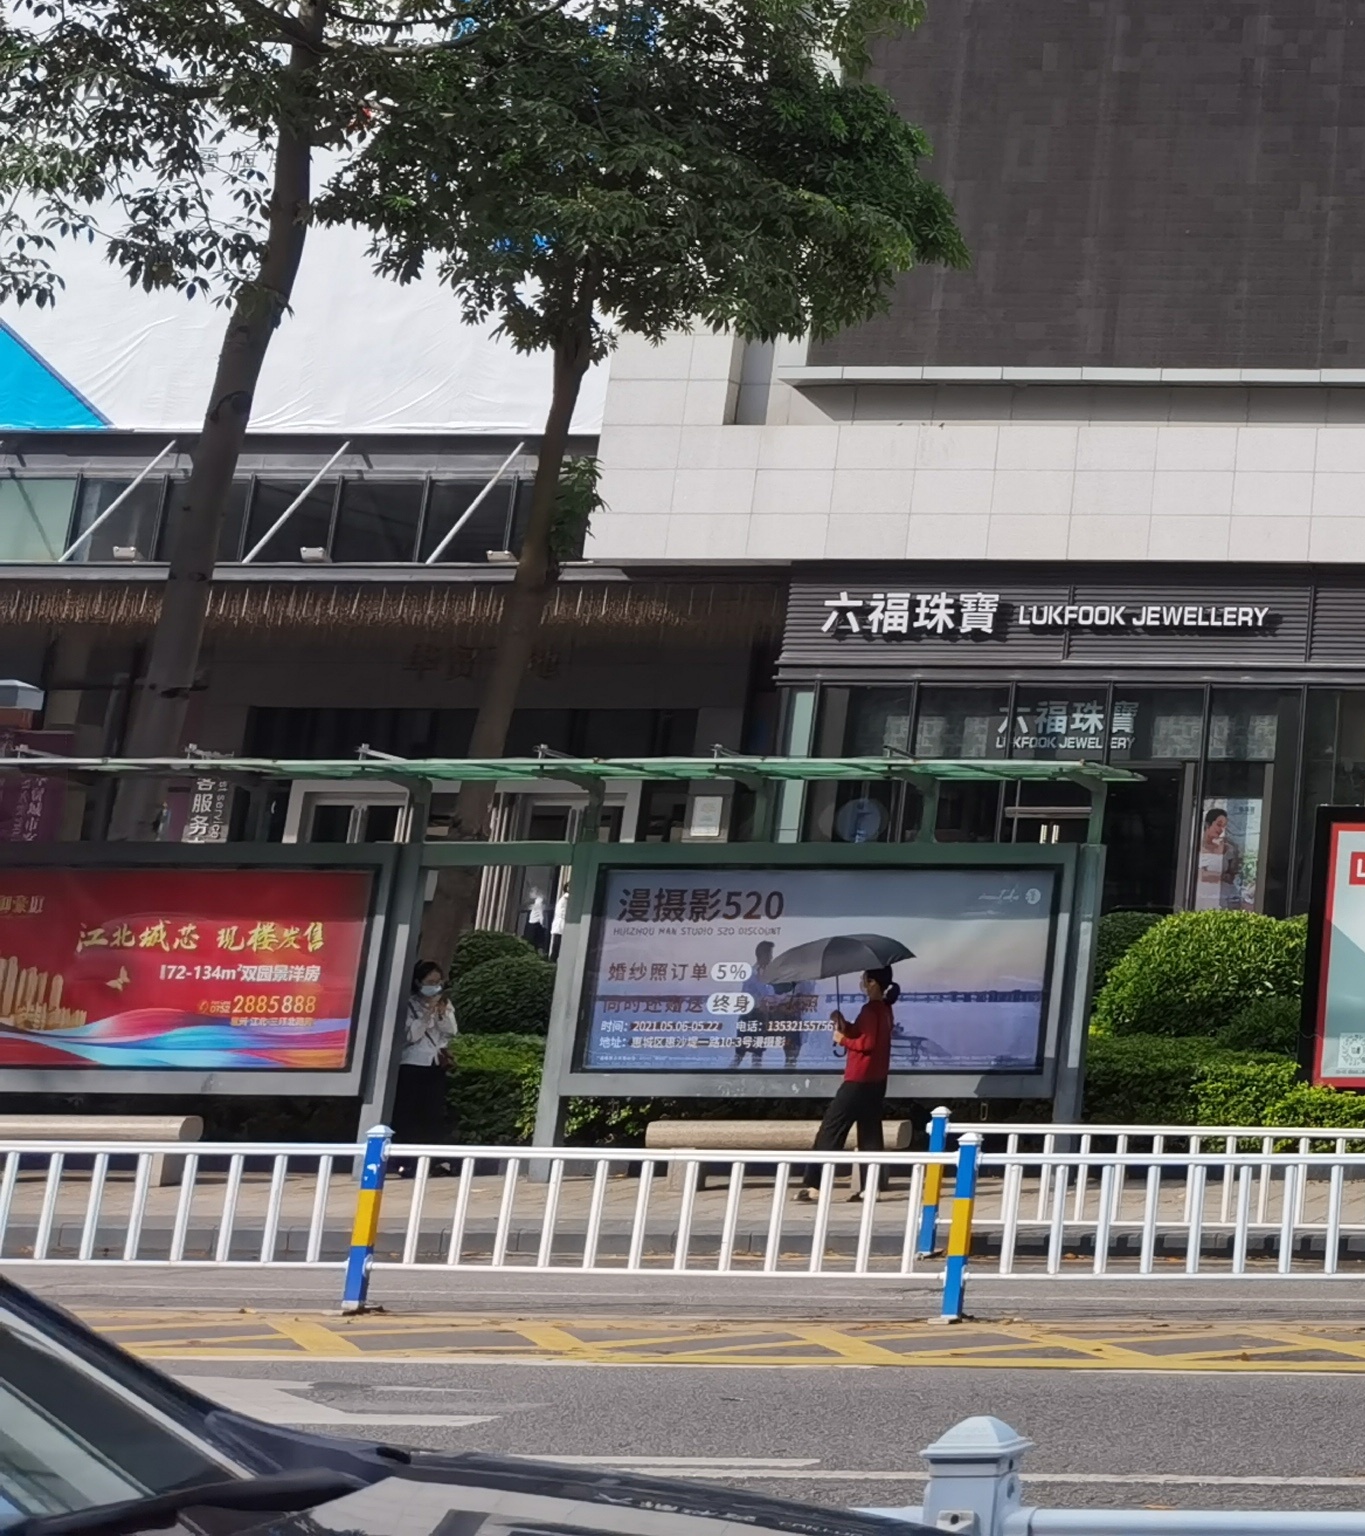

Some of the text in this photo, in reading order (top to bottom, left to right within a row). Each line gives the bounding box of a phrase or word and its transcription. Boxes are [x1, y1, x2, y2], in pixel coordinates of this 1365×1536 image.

[821, 591, 1000, 634] 六福珠寶
[1018, 605, 1270, 627] LUKFOOK JEWELLERY
[1058, 736, 1136, 750] JEWELERY
[617, 887, 785, 924] 漫摄影520
[77, 919, 326, 954] 江北城芯 现楼发售
[608, 962, 709, 982] 婚纱照订单
[232, 995, 316, 1014] 2885888
[712, 994, 751, 1014] 终身
